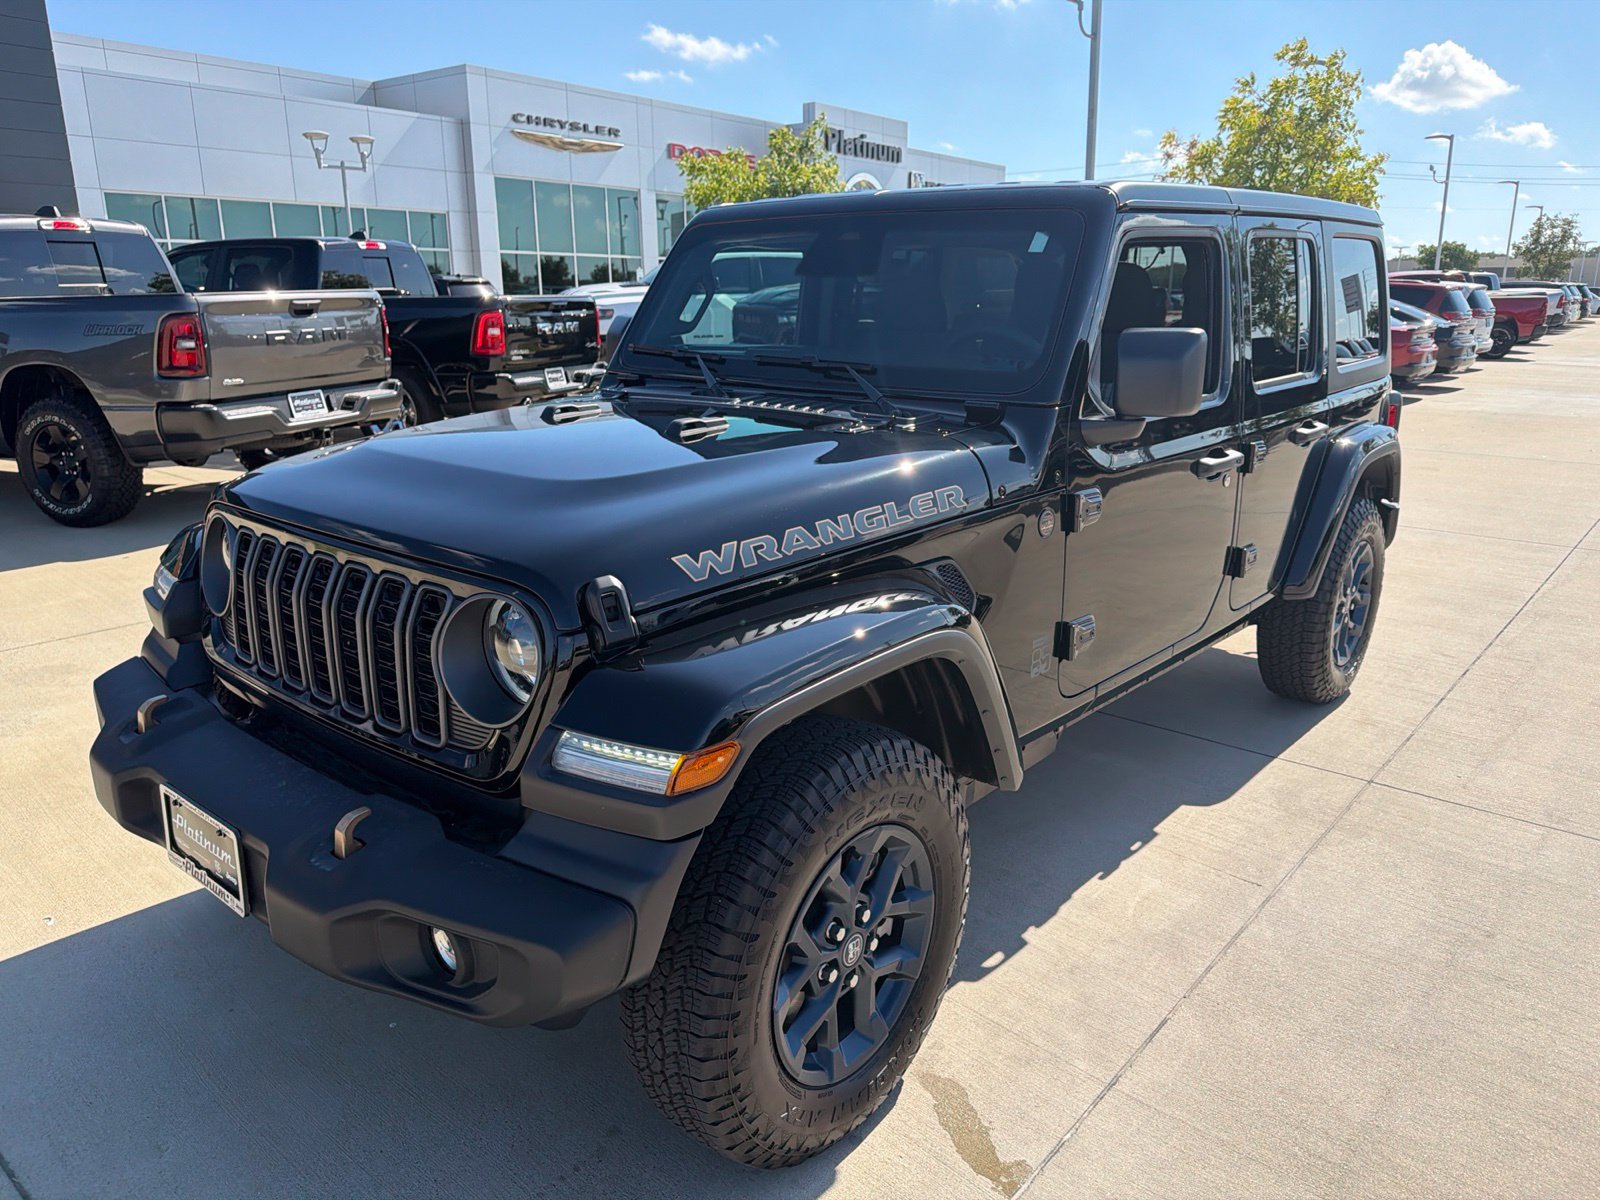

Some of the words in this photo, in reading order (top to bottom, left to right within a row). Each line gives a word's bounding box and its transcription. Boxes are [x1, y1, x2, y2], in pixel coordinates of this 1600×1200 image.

[512, 113, 621, 138] CHRYSLER
[824, 127, 902, 163] Platinum
[83, 323, 145, 337] WARLOCK
[265, 326, 346, 345] RAM
[536, 321, 580, 335] RAM
[671, 485, 967, 582] WRANGLER
[173, 813, 236, 870] Platinum
[824, 793, 925, 856] NEXEN
[185, 860, 231, 904] Platinum
